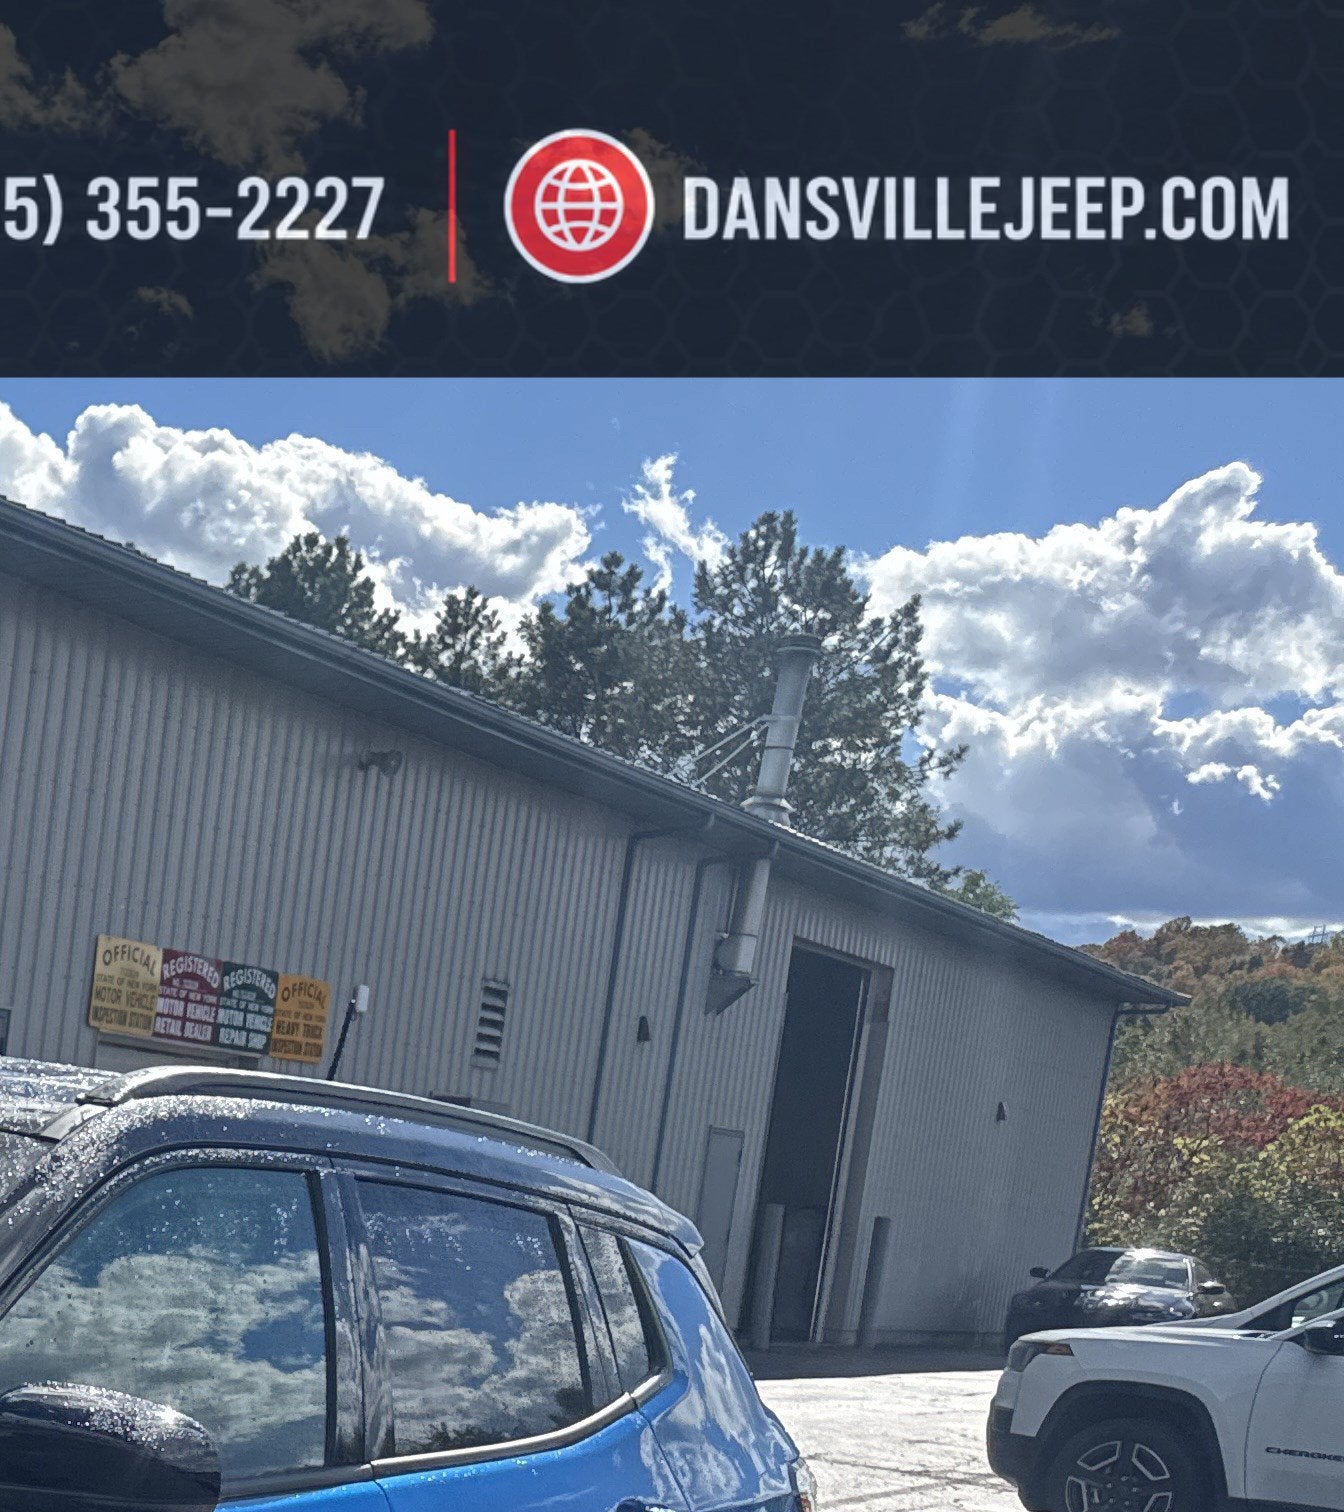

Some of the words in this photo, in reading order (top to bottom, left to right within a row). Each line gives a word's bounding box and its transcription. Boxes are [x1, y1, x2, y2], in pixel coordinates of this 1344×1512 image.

[103, 944, 156, 976] OFFICIAL
[163, 955, 219, 988] REGISTERED
[223, 968, 276, 999] REGISTERED
[281, 981, 326, 1009] OFFICIAL
